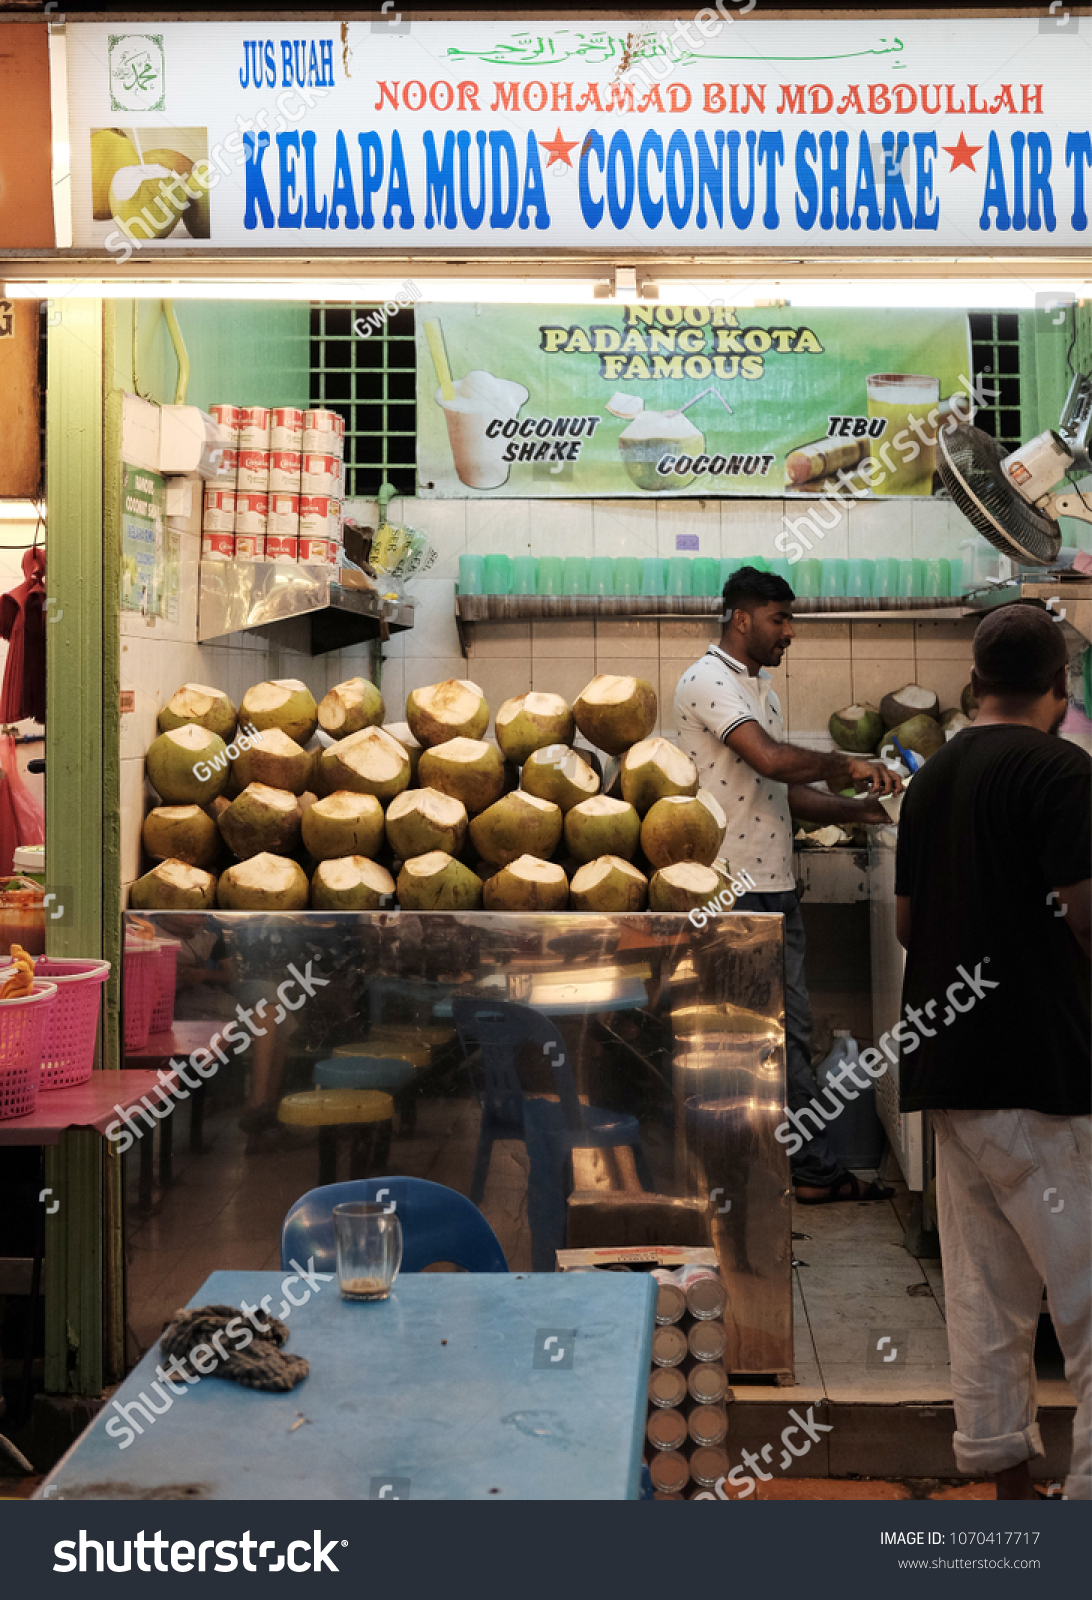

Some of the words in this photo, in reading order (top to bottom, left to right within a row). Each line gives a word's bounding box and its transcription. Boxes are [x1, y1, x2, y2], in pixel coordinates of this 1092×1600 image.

[240, 39, 277, 89] JUS
[281, 39, 335, 87] BUAH
[375, 80, 480, 111] NOOR
[491, 81, 693, 113] MOHAMAD
[702, 82, 767, 114] BIN
[242, 129, 415, 230] KELAPA
[423, 129, 551, 230] MUDA
[578, 129, 784, 231] COCONUT
[795, 130, 940, 231] SHAKE
[979, 130, 1057, 232] AIR
[624, 304, 737, 328] NOOR
[541, 326, 707, 353] PADANG
[714, 327, 824, 354] KOTA
[600, 355, 765, 381] FAMOUS
[485, 416, 601, 439] COCONUT
[827, 416, 888, 438] TEBU
[501, 440, 582, 463] SHAKE
[657, 454, 775, 477] COCONUT
